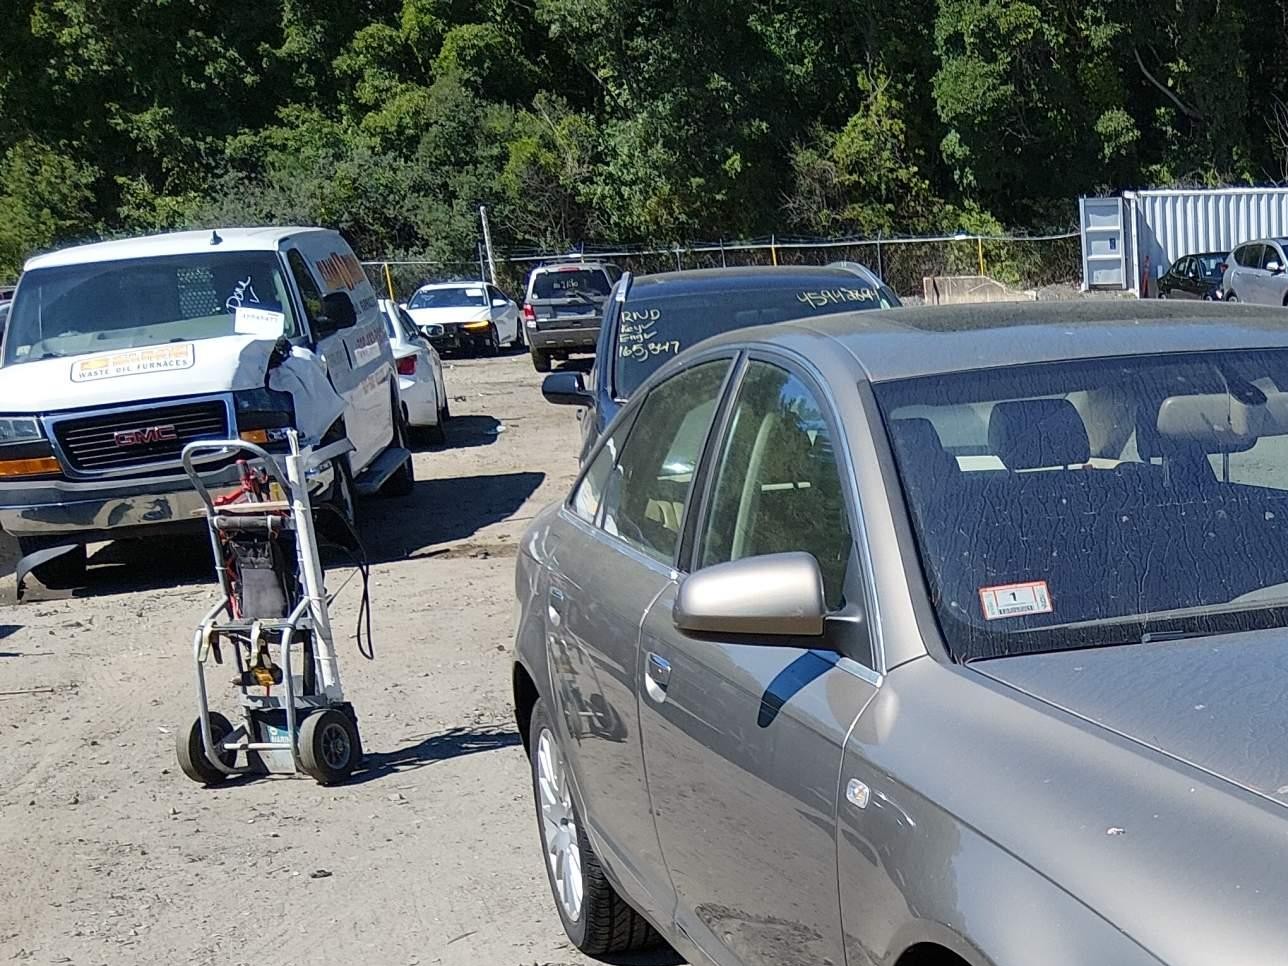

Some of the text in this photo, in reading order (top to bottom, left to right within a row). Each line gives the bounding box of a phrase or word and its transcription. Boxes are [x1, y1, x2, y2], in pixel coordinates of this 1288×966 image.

[79, 368, 110, 379] WASTE
[113, 424, 178, 447] GMC
[1009, 592, 1017, 601] 1
